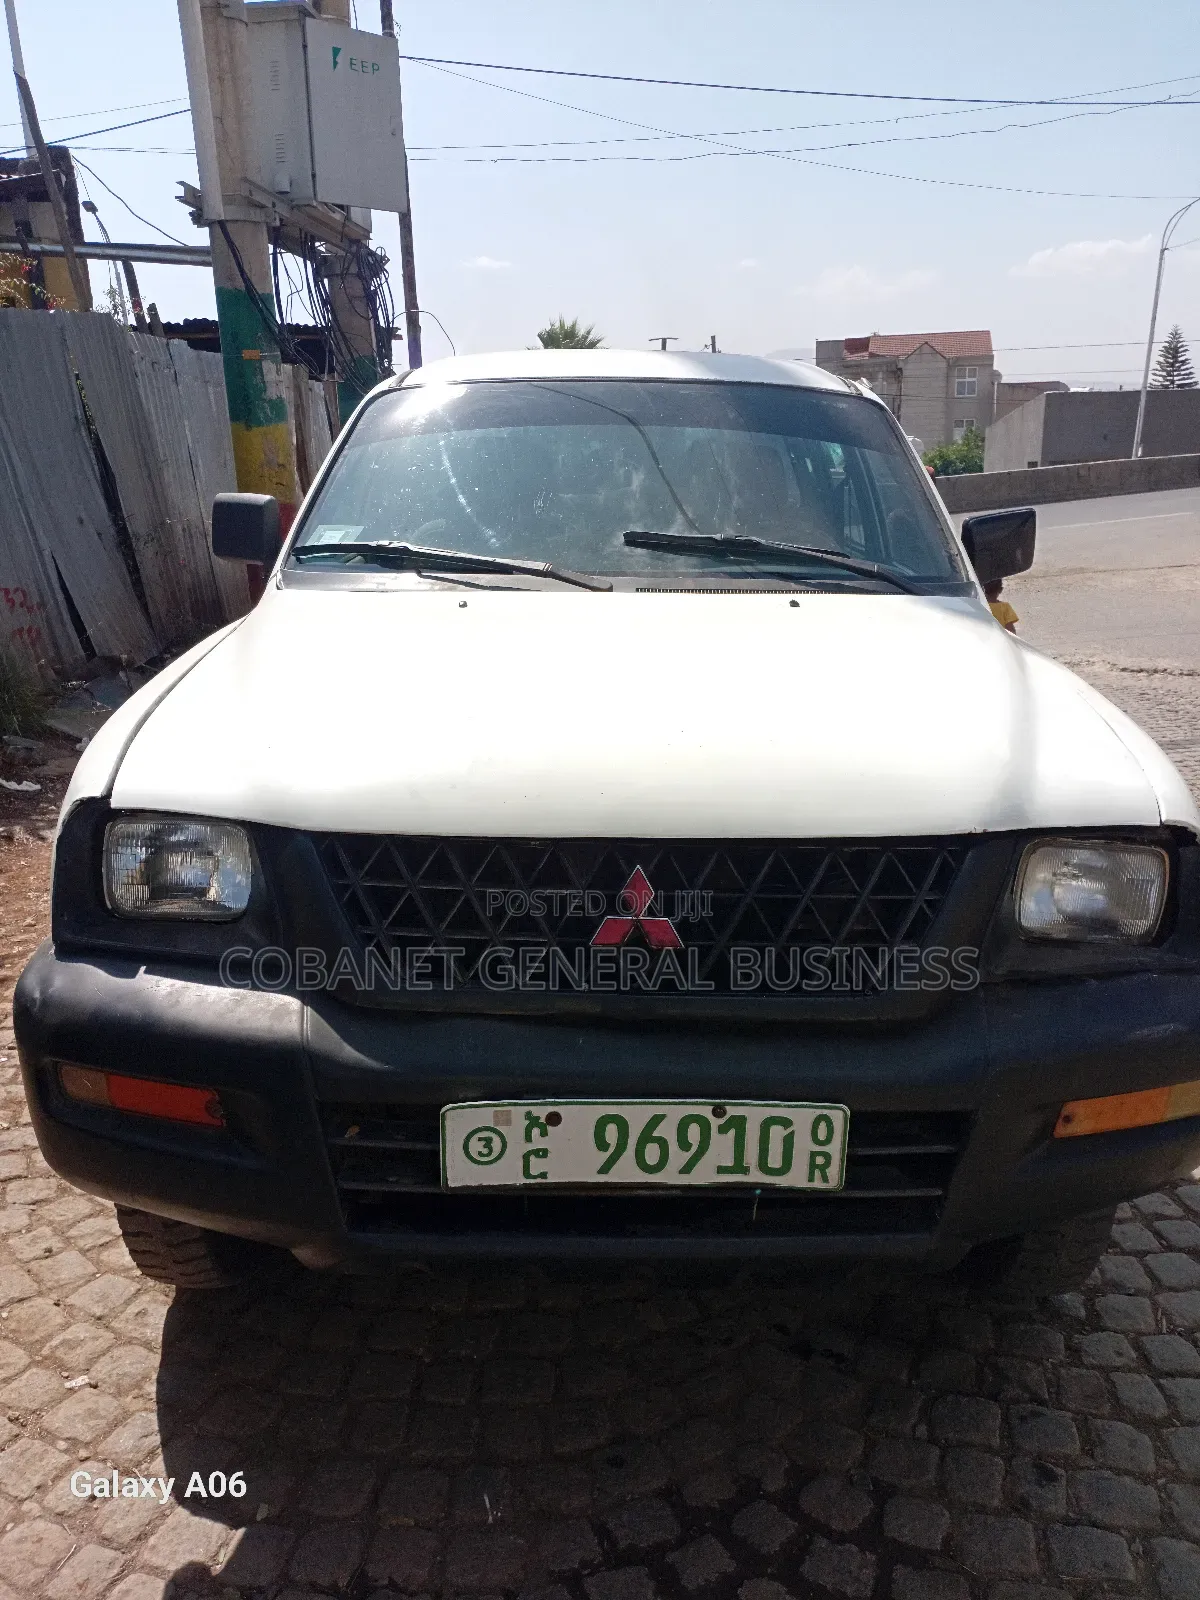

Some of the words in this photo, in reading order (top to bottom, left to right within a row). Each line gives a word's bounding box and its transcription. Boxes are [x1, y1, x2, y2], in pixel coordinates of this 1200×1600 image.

[350, 57, 380, 75] EEP
[477, 1135, 494, 1158] 3
[593, 1113, 795, 1177] 96910
